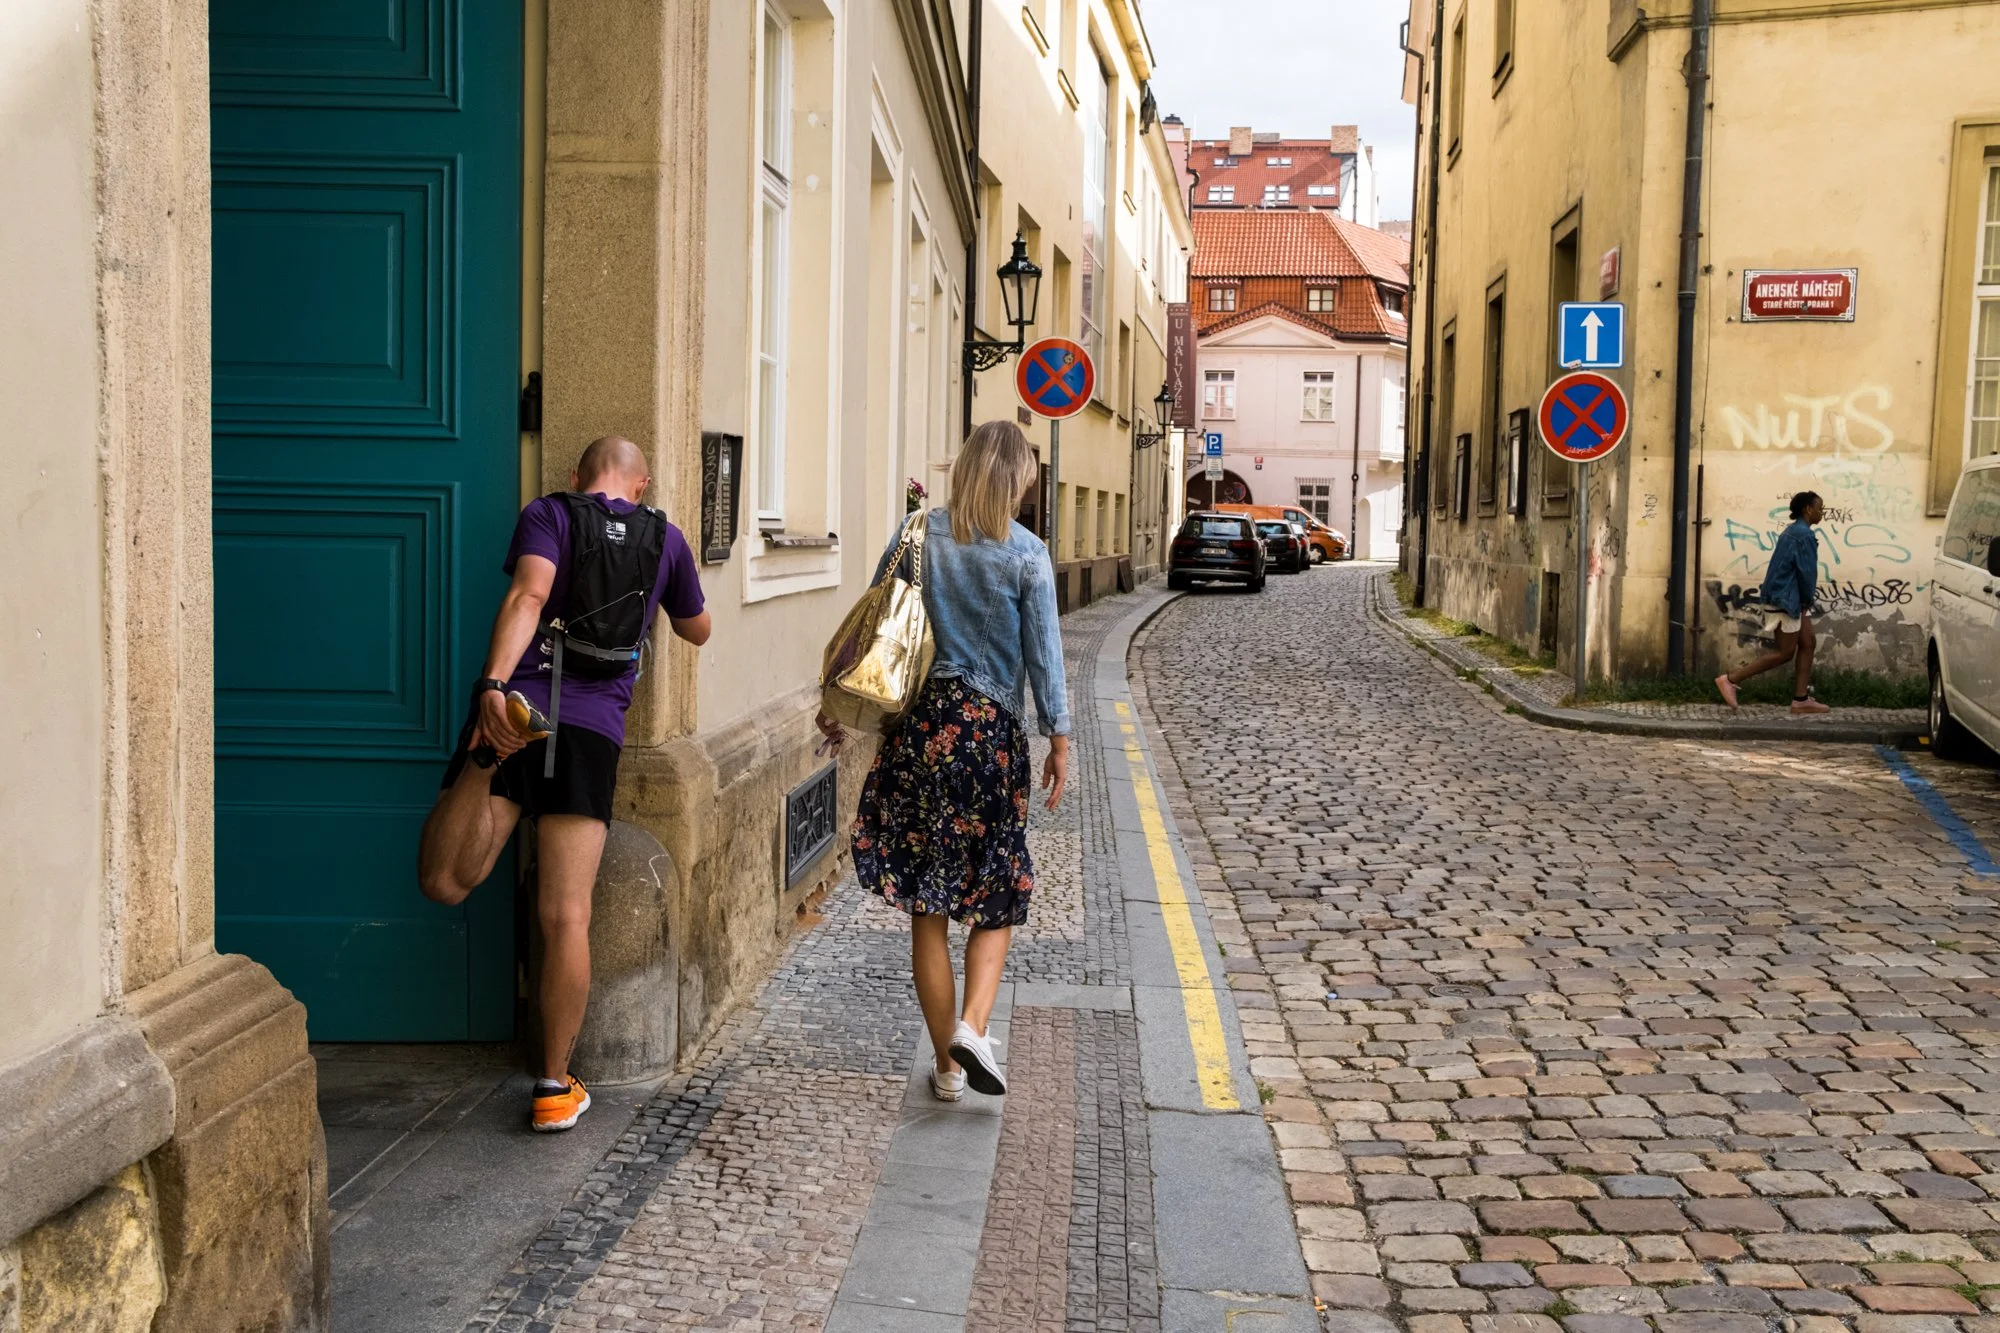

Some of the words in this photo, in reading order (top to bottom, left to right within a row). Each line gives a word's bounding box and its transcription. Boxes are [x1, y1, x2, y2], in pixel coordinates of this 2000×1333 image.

[1755, 280, 1799, 298] ANENSKÉ
[1802, 280, 1843, 297] NÁMĚSTÍ
[1762, 299, 1783, 310] STARÉ
[1807, 300, 1830, 309] PRAHA
[1831, 300, 1834, 309] 1
[1175, 318, 1184, 330] U
[1209, 435, 1220, 450] P
